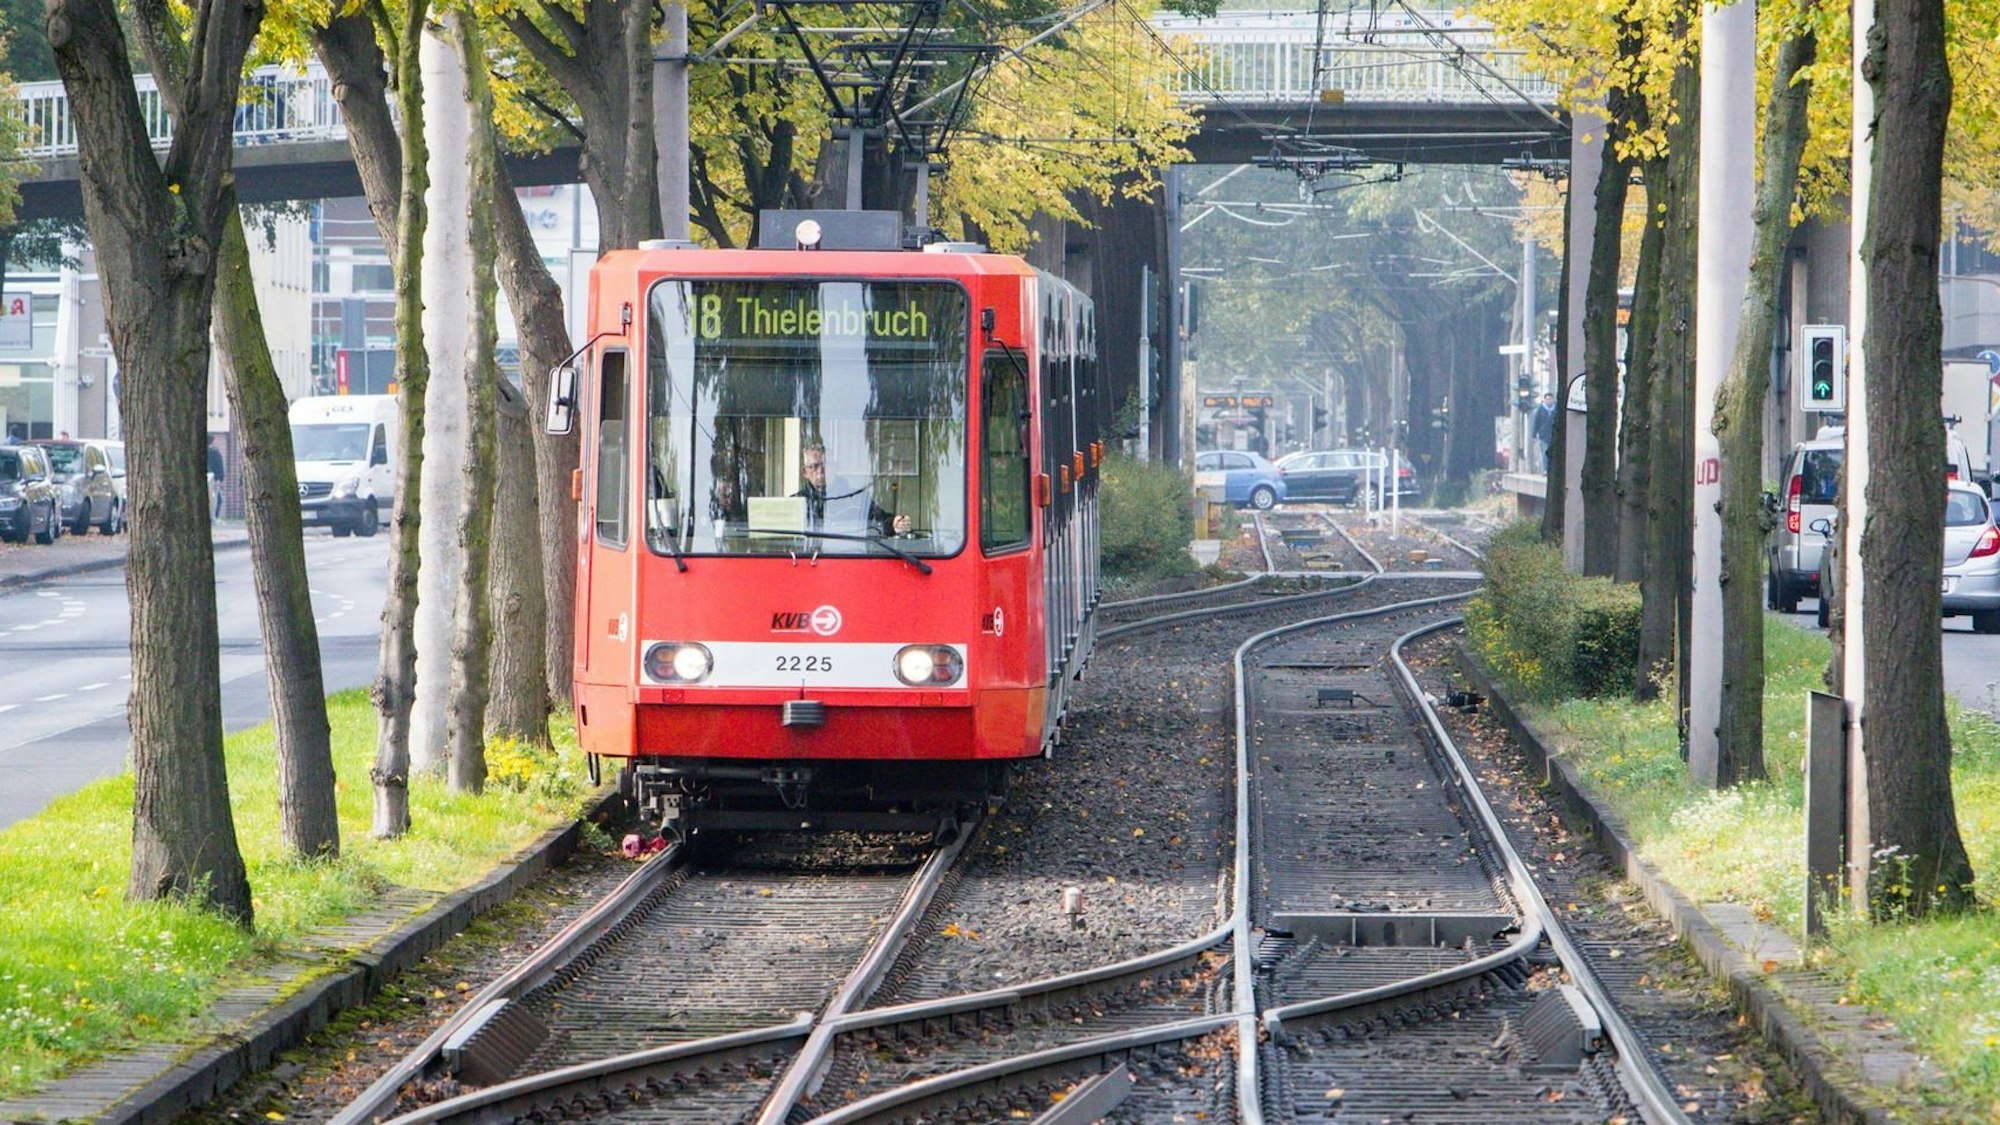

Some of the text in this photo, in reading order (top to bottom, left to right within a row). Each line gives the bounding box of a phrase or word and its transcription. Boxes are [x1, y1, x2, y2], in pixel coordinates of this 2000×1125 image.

[689, 294, 928, 339] 18 Thielenbruch
[771, 612, 811, 629] KVB
[776, 655, 832, 672] 2225
